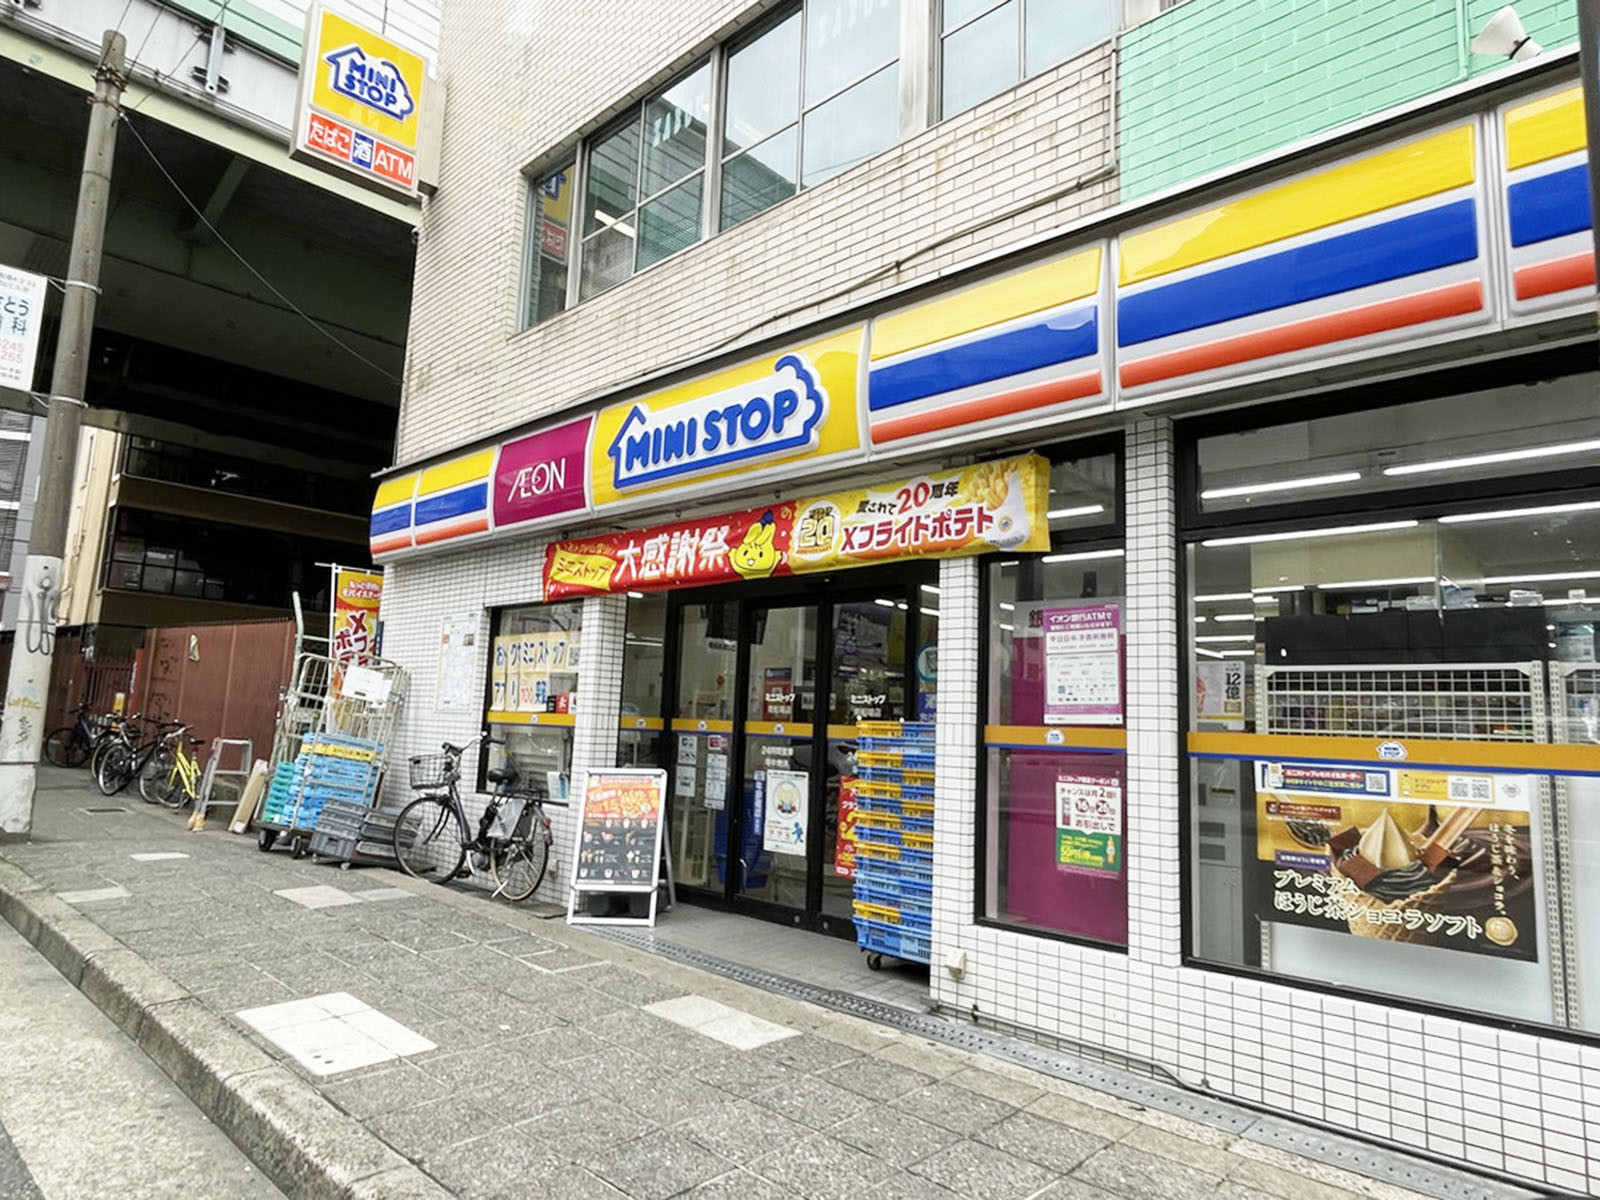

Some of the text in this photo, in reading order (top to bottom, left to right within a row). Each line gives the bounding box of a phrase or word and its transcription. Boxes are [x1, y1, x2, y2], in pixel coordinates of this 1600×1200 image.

[344, 74, 398, 107] STOP
[349, 58, 397, 94] MINI
[310, 120, 413, 179] たばこ 酒 ATM
[624, 388, 800, 471] MINI STOP
[841, 506, 993, 552] Xフライドポテト
[614, 524, 731, 582] 大感謝祭
[765, 692, 796, 703] ミニストップ
[850, 694, 886, 705] ミニストップ
[1273, 869, 1361, 896] プレミアム
[1273, 890, 1483, 939] ほうじ茶ショコラソフト
